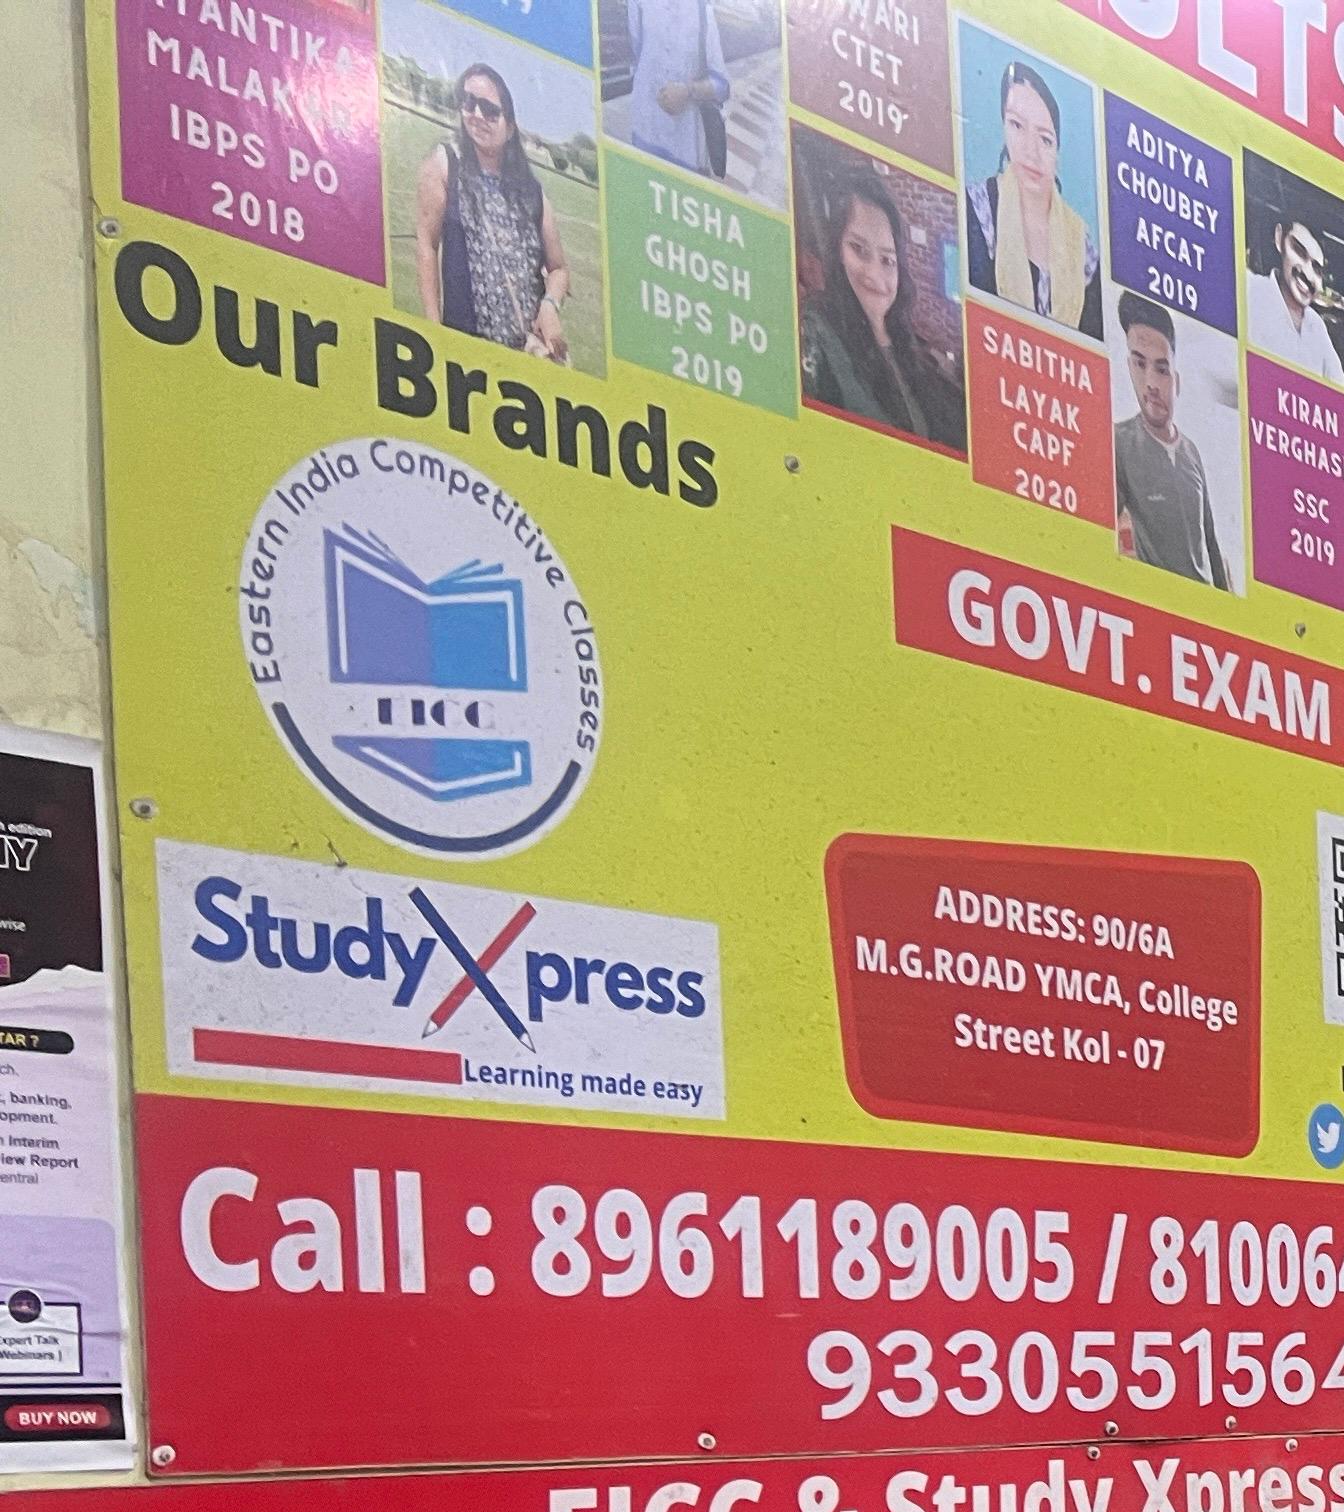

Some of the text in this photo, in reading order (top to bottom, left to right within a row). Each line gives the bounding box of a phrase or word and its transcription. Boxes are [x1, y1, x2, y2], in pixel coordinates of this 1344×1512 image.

[154, 0, 352, 74] ANTIKA
[832, 29, 903, 87] CTET
[838, 81, 903, 134] 2019
[170, 104, 338, 194] IBPS PO
[1126, 122, 1209, 189] ADITYA
[211, 181, 304, 242] 2018
[650, 181, 745, 247] TISHA
[1117, 161, 1219, 234] CHOUBEY
[646, 236, 750, 300] GHOSH
[1136, 216, 1205, 272] AFCAT
[641, 281, 767, 354] IBPS PO
[1148, 266, 1199, 312] 2019
[114, 241, 719, 509] Our Brands
[672, 347, 744, 397] 2019
[982, 326, 1092, 394] SABITHA
[1000, 377, 1081, 433] LAYAK
[1278, 386, 1339, 437] KIRAN
[1012, 422, 1076, 467] CAPF
[1014, 469, 1078, 514] 2020
[1294, 489, 1330, 524] SSC
[1291, 528, 1335, 566] 2019
[245, 440, 603, 753] Eastern India Competitive Classes
[948, 569, 1152, 692] GOVT.
[1172, 634, 1330, 745] EXAM
[934, 886, 1174, 960] ADDRESS: 90/6A
[855, 936, 1238, 1031] M.G.ROAD YMCA, College
[955, 1012, 1165, 1071] Street Kol 07
[464, 1057, 703, 1107] Learning made easy
[30, 1155, 79, 1168] Report
[181, 1167, 425, 1294] Call
[531, 1184, 1074, 1303] 8961189005
[19, 1411, 97, 1426] BUY NOW
